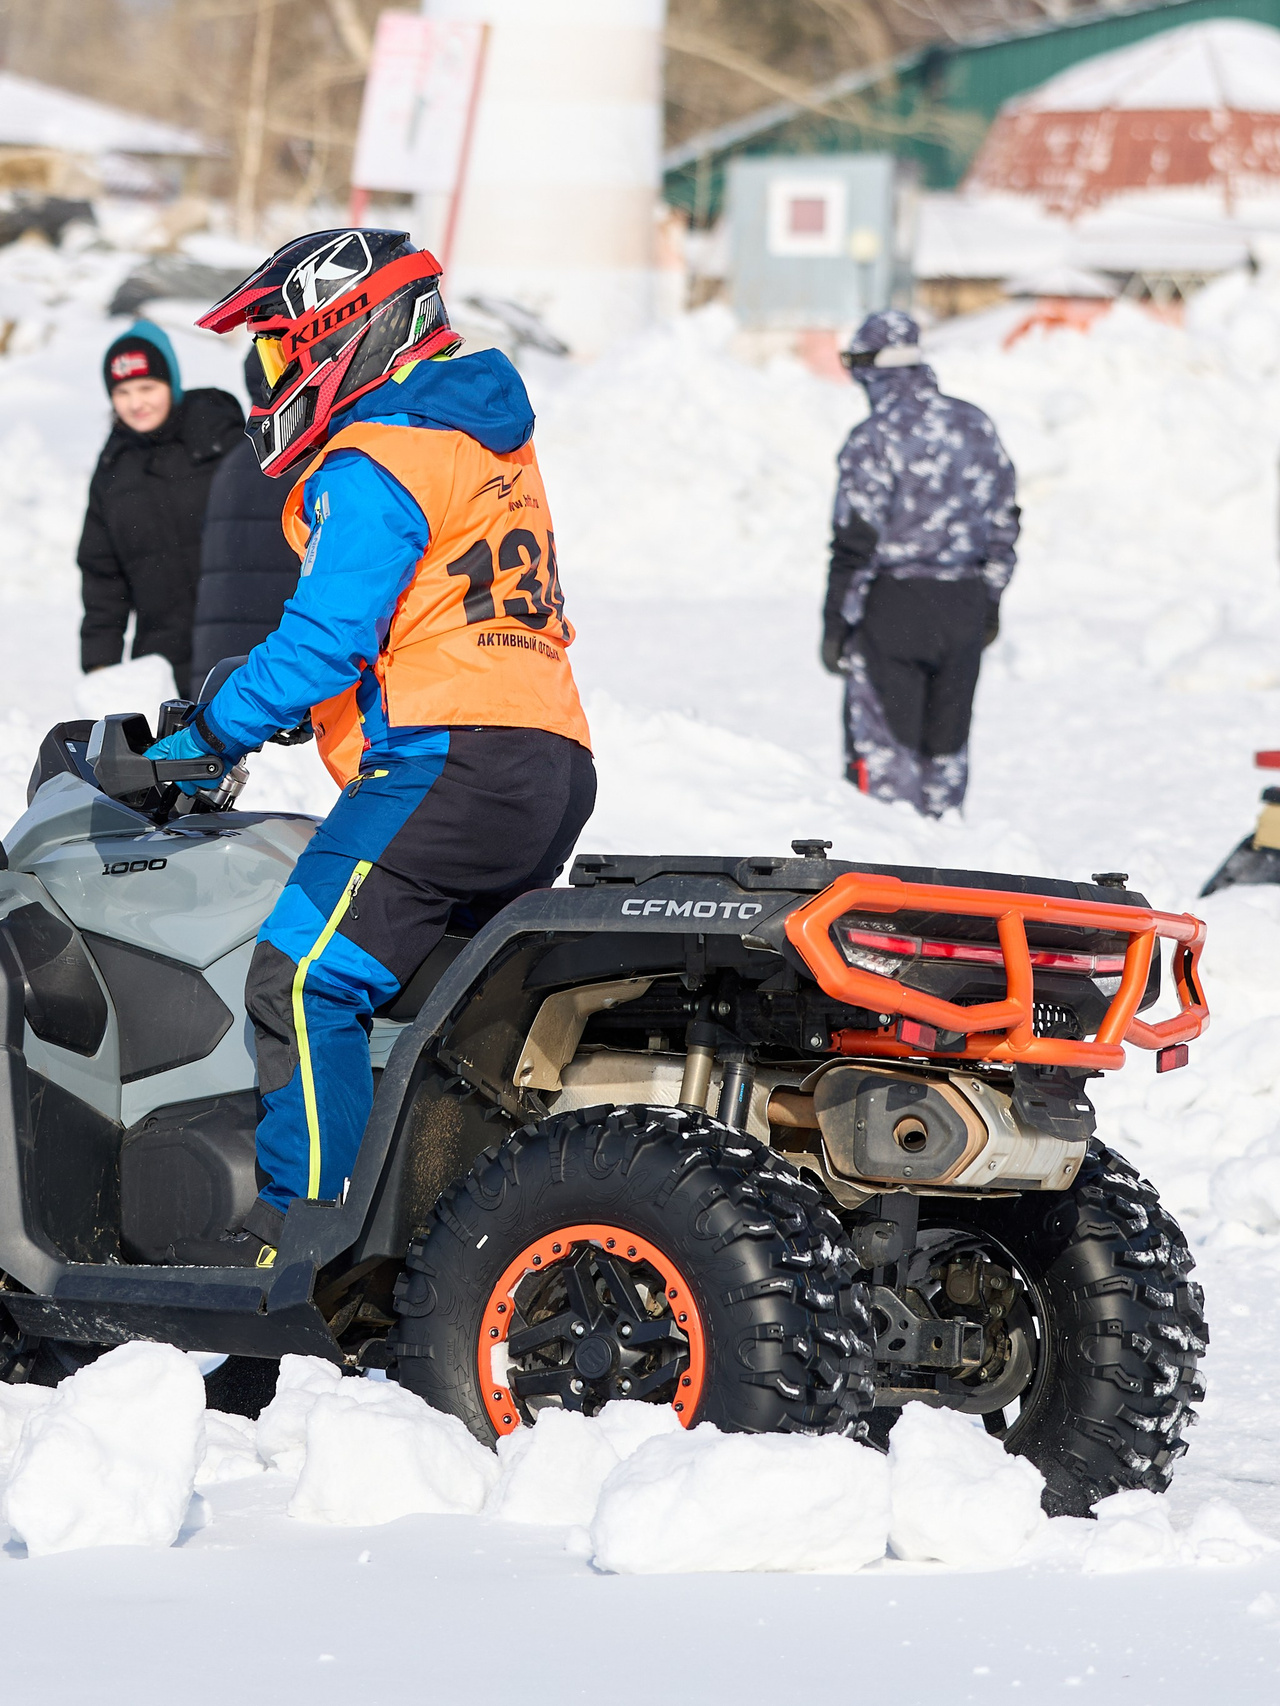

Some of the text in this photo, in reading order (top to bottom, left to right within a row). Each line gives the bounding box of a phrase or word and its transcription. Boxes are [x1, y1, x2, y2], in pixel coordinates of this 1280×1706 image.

[477, 633, 562, 663] АКТИВНЫЙ ОТДЫХ
[102, 858, 168, 876] 1000
[621, 898, 763, 920] CFMOTO
